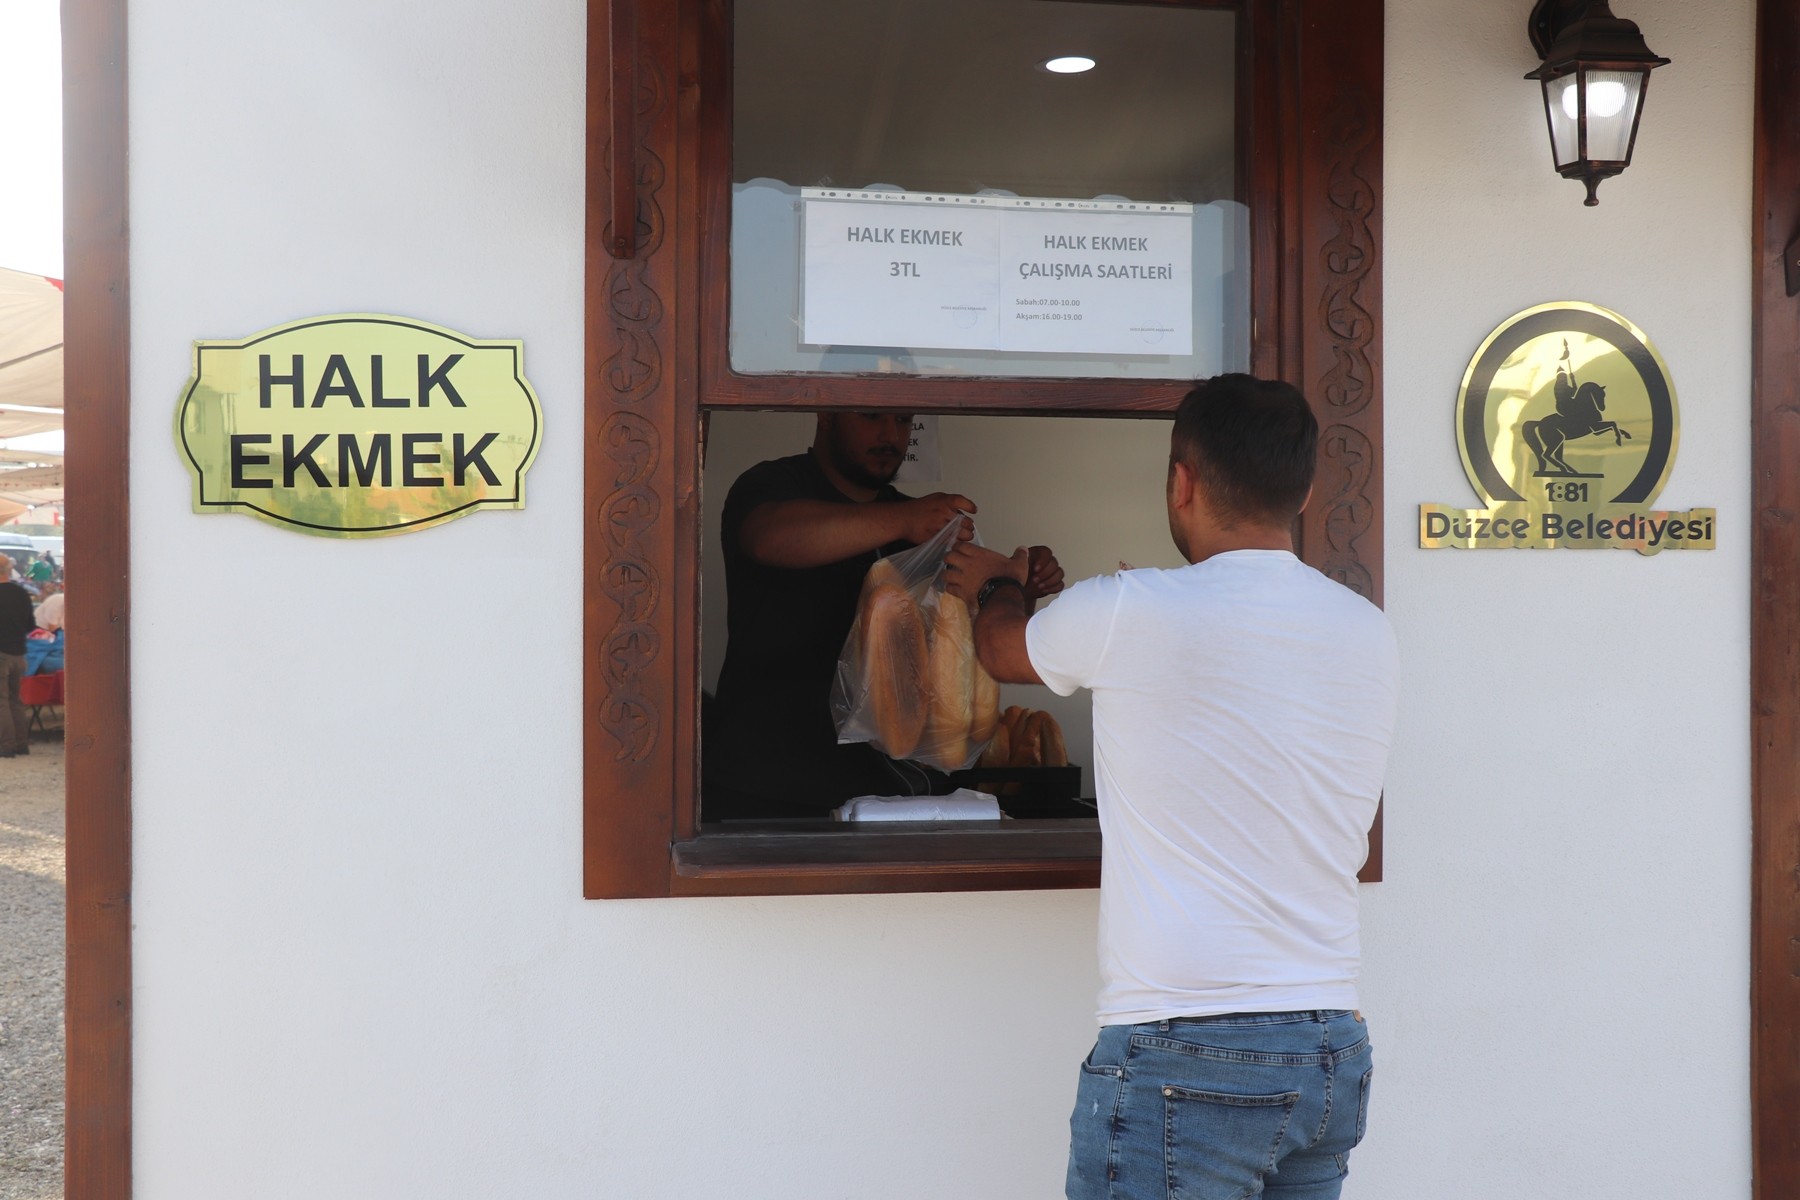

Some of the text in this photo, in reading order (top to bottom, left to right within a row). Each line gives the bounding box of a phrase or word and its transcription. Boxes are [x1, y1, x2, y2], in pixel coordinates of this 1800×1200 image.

[847, 226, 963, 247] HALK EKMEK
[1043, 234, 1149, 252] HALK EKMEK
[889, 262, 921, 278] 3TL
[1018, 262, 1173, 281] ÇALIŞMA SAATLERİ
[259, 354, 467, 408] HALK
[230, 433, 502, 488] EKMEK
[1425, 511, 1712, 546] Düzce Belediyesi
